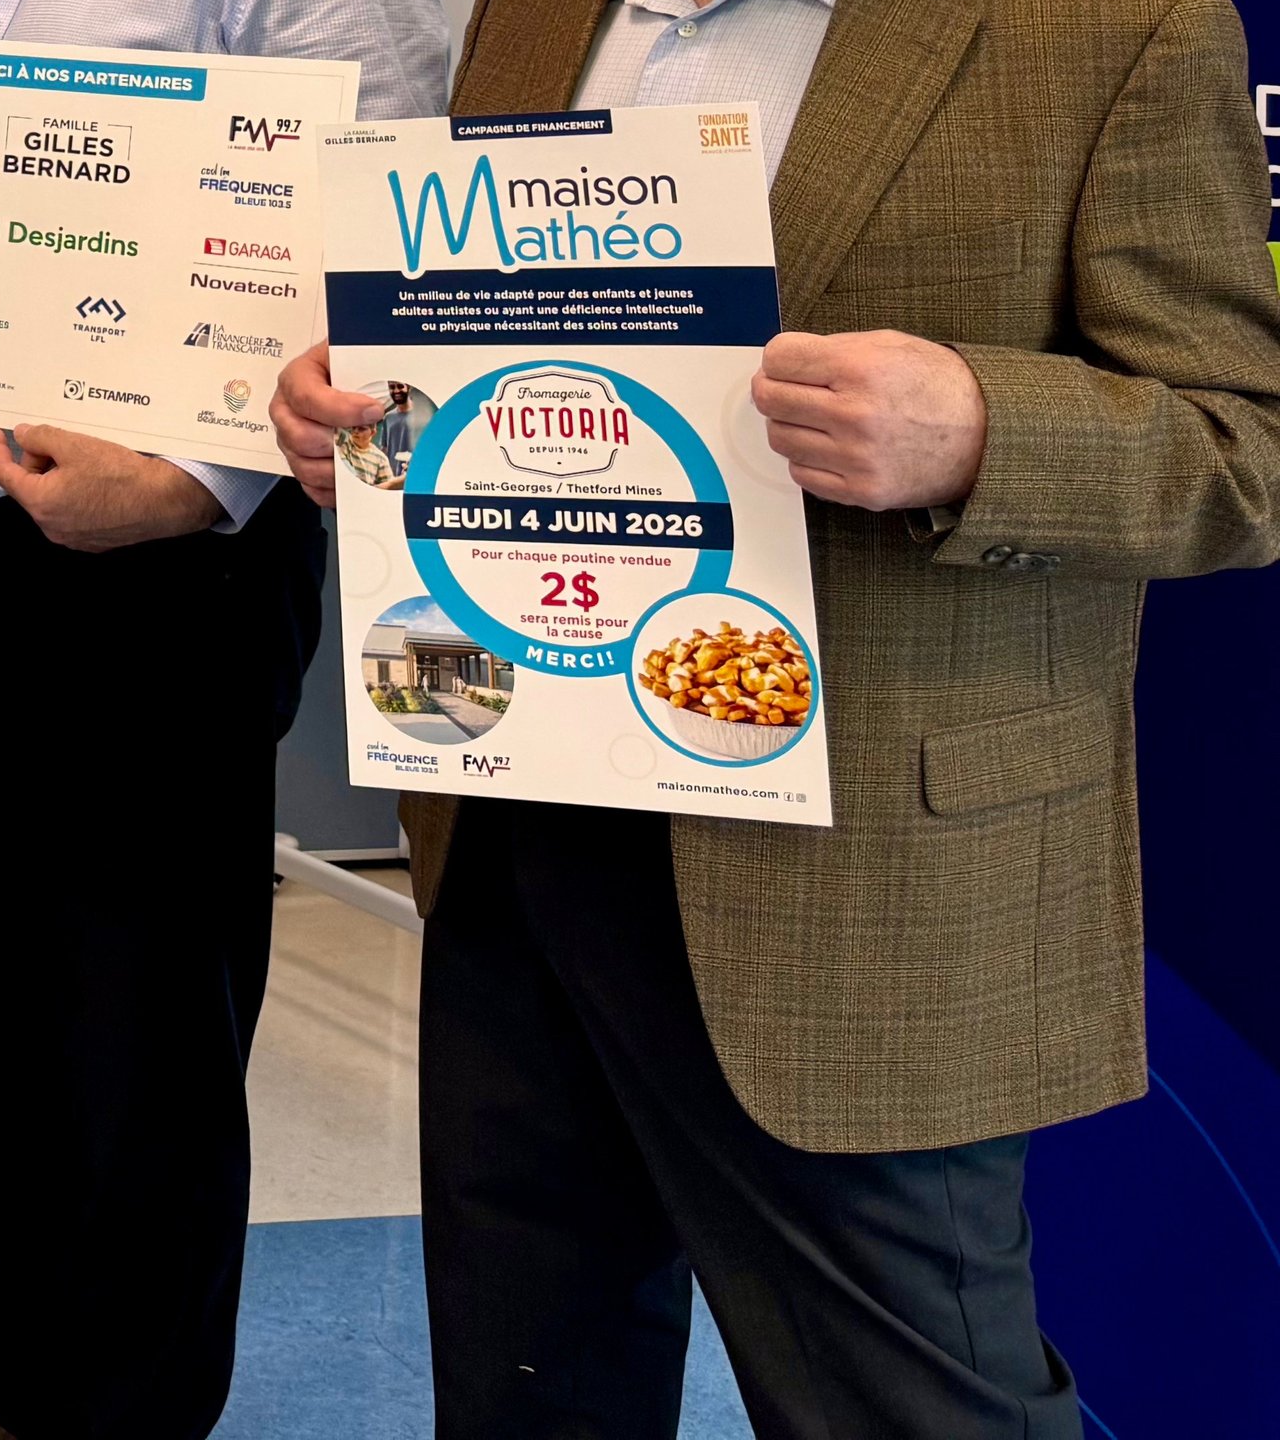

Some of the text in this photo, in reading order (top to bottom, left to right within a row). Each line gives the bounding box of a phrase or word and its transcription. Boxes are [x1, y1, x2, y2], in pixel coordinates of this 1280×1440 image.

[16, 60, 30, 79] À
[34, 68, 70, 82] NOS
[74, 70, 192, 91] PARTENAIRES
[43, 118, 98, 132] FAMILLE
[276, 118, 301, 133] 99.7
[458, 120, 605, 135] CAMPAGNE DE FINANCEMENT
[698, 113, 748, 127] FONDATION
[24, 132, 114, 156] GILLES
[700, 124, 751, 148] SANTÉ
[3, 154, 130, 184] BERNARD
[199, 176, 294, 197] FRÉQUENCE
[509, 166, 678, 208] maison
[387, 155, 682, 273] Mathéo
[8, 221, 139, 260] Desjardins
[228, 242, 292, 261] GARAGA
[190, 273, 297, 298] Novatech
[399, 288, 693, 301] Un milieu de vie adapté pour des enfants et jeunes
[392, 307, 433, 316] adultes
[437, 306, 481, 315] autistes
[484, 307, 498, 315] ou
[502, 306, 534, 316] ayant
[562, 304, 622, 314] déficience
[626, 304, 703, 314] intellectuelle
[73, 324, 126, 336] TRANSPORT
[440, 321, 491, 332] physique
[494, 321, 560, 330] nécessitant
[563, 321, 584, 330] des
[588, 320, 617, 330] soins
[621, 320, 679, 330] constants
[90, 335, 106, 343] LFL
[212, 330, 265, 346] FINANCIÈRE
[212, 342, 283, 358] TRANSCAPITALE
[88, 387, 150, 406] ESTAMPRO
[518, 387, 592, 402] Fromagerie
[486, 407, 629, 446] VICTORIA
[568, 447, 588, 455] 1946
[465, 482, 662, 495] Saint-Georges Thetford Mines
[426, 506, 703, 537] JEUDI 4 JUIN 2026
[472, 549, 672, 566] Pour chaque poutine vendue
[540, 571, 599, 612] 2$
[520, 614, 628, 630] sera remis pour
[546, 627, 603, 640] la cause
[526, 646, 615, 668] MERCI!
[367, 750, 438, 766] FRÉQUENCE
[657, 781, 779, 800] maisonmatheo.com
